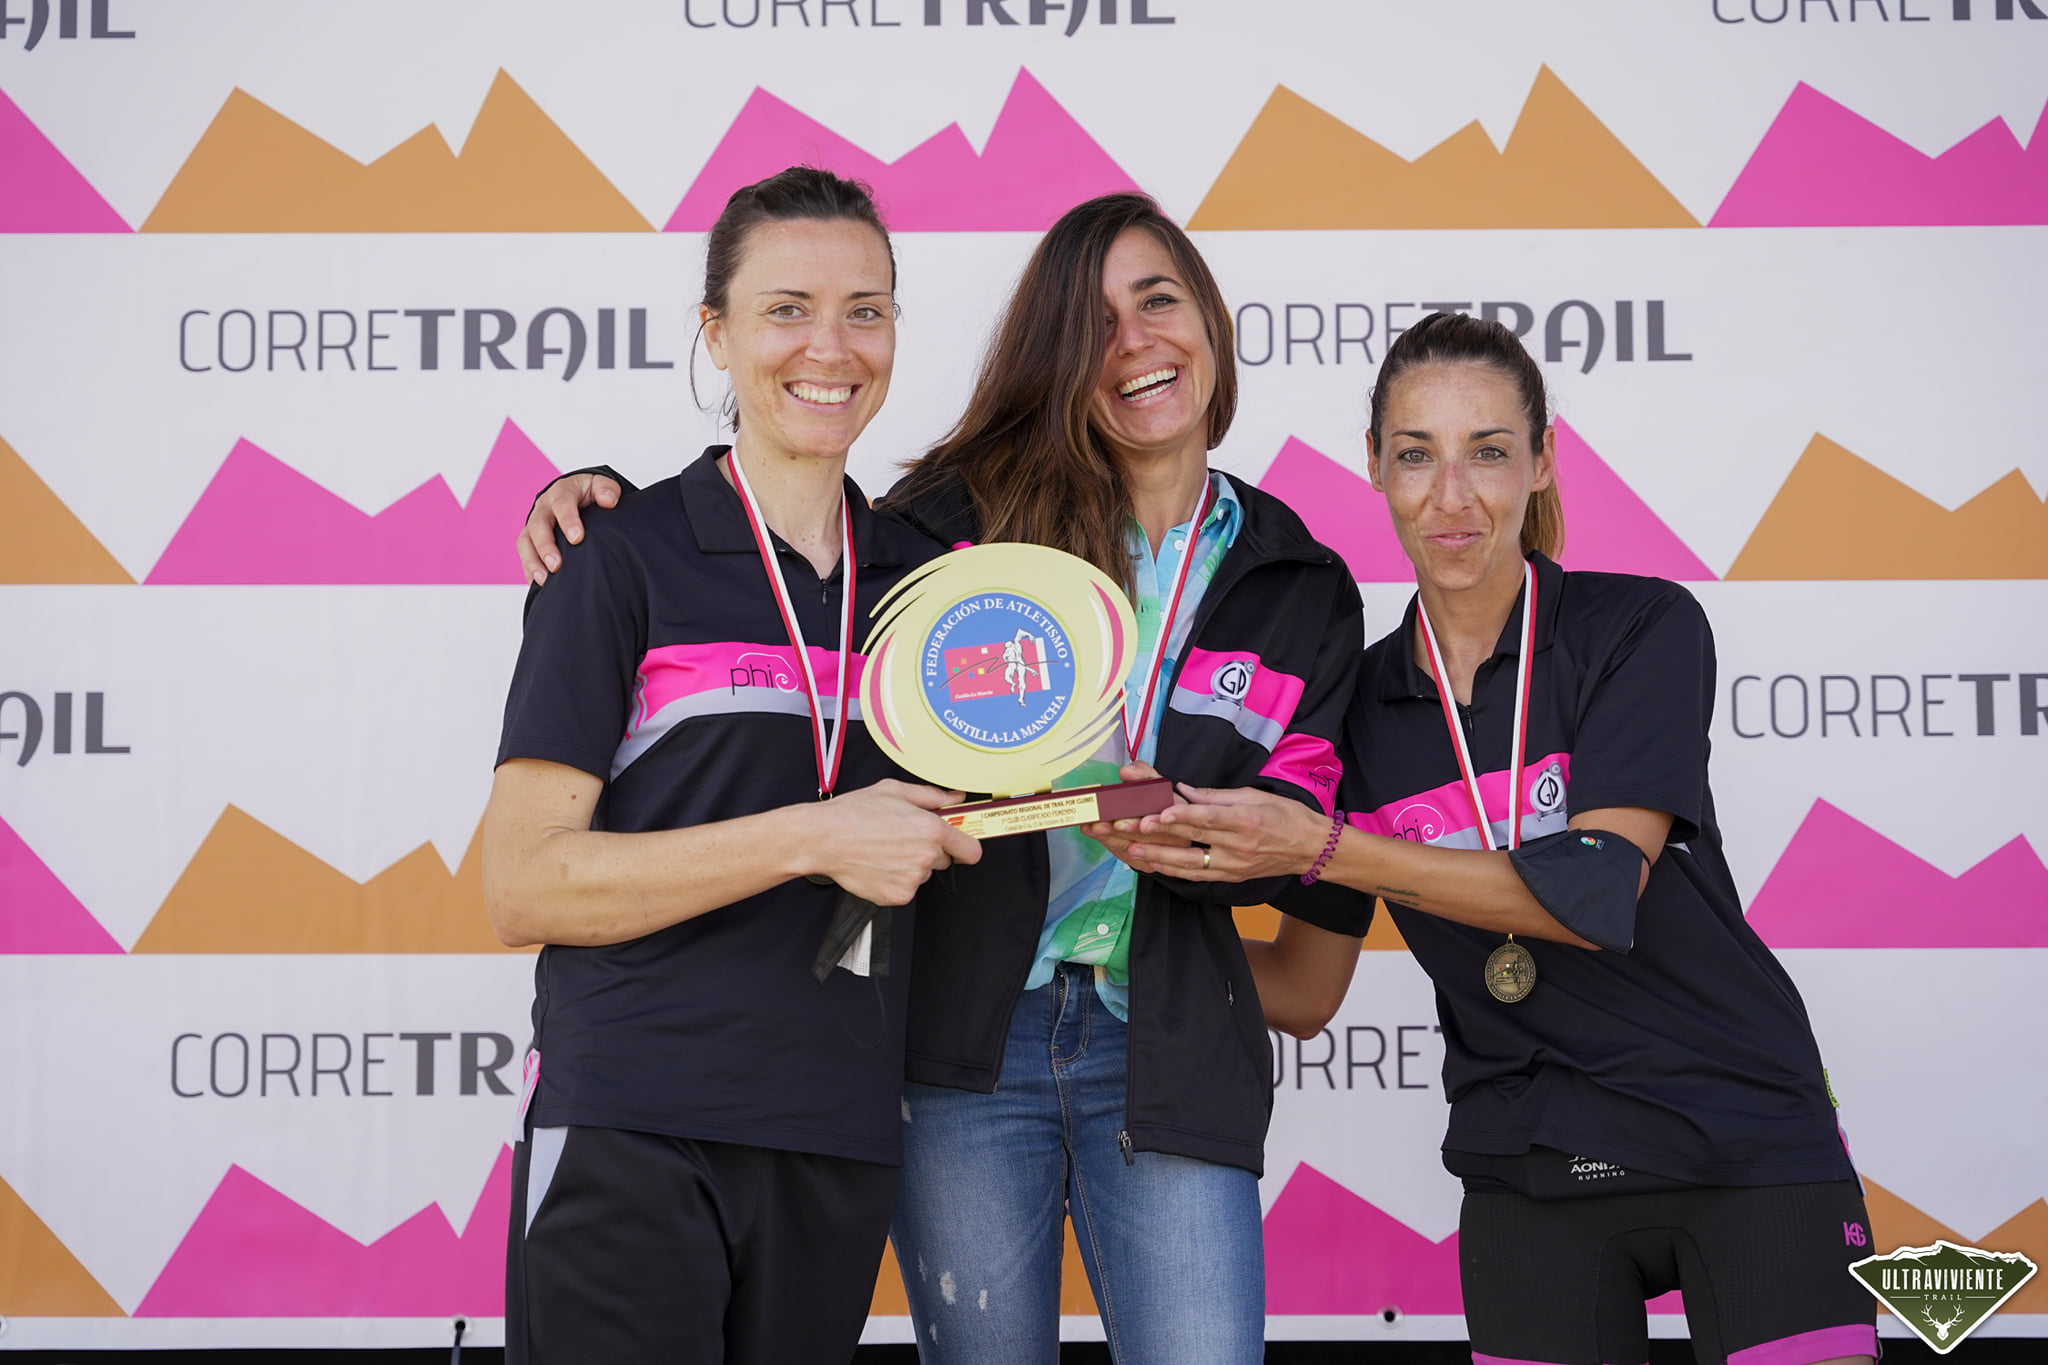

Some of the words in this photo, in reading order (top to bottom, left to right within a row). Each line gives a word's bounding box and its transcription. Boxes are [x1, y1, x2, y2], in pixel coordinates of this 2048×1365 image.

[180, 307, 674, 382] CORRETRAIL
[926, 600, 981, 676] FEDERACIÓN
[984, 598, 1004, 609] DE
[1006, 600, 1068, 658] ATLETISMO
[1021, 695, 1066, 738] MANCHA
[171, 1032, 516, 1098] CORRETR
[1578, 1170, 1626, 1181] RUNNING
